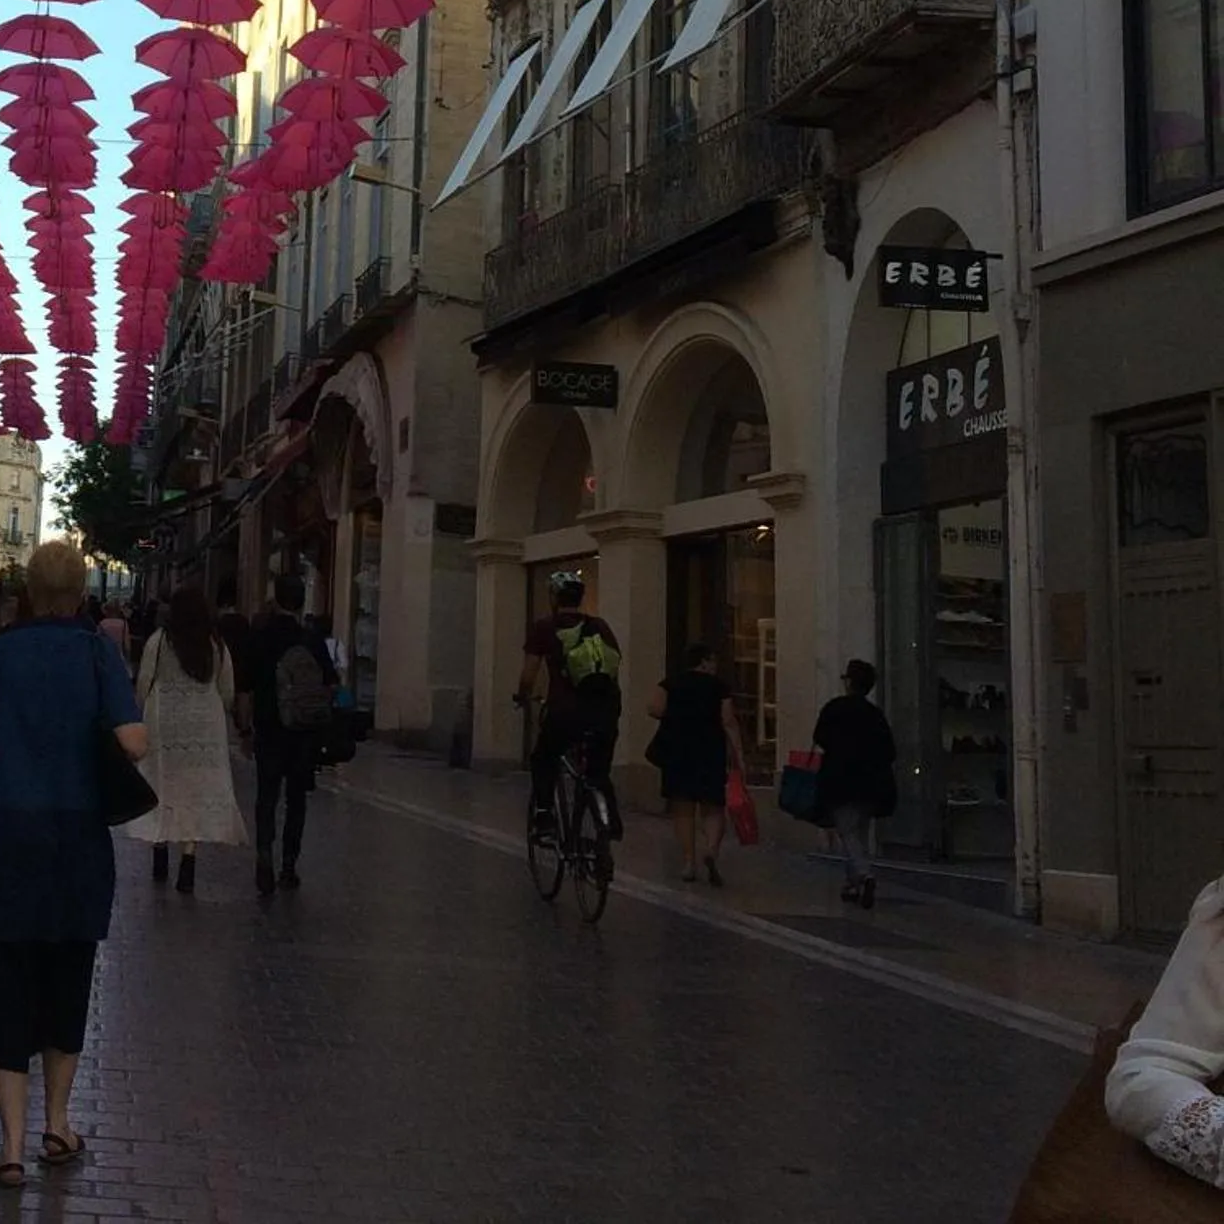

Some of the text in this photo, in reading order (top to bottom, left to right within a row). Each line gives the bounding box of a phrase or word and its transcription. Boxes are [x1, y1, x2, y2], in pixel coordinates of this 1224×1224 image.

[885, 261, 984, 288] ERBÉ
[537, 369, 613, 392] BOCAGE
[899, 344, 991, 431] ERBÉ
